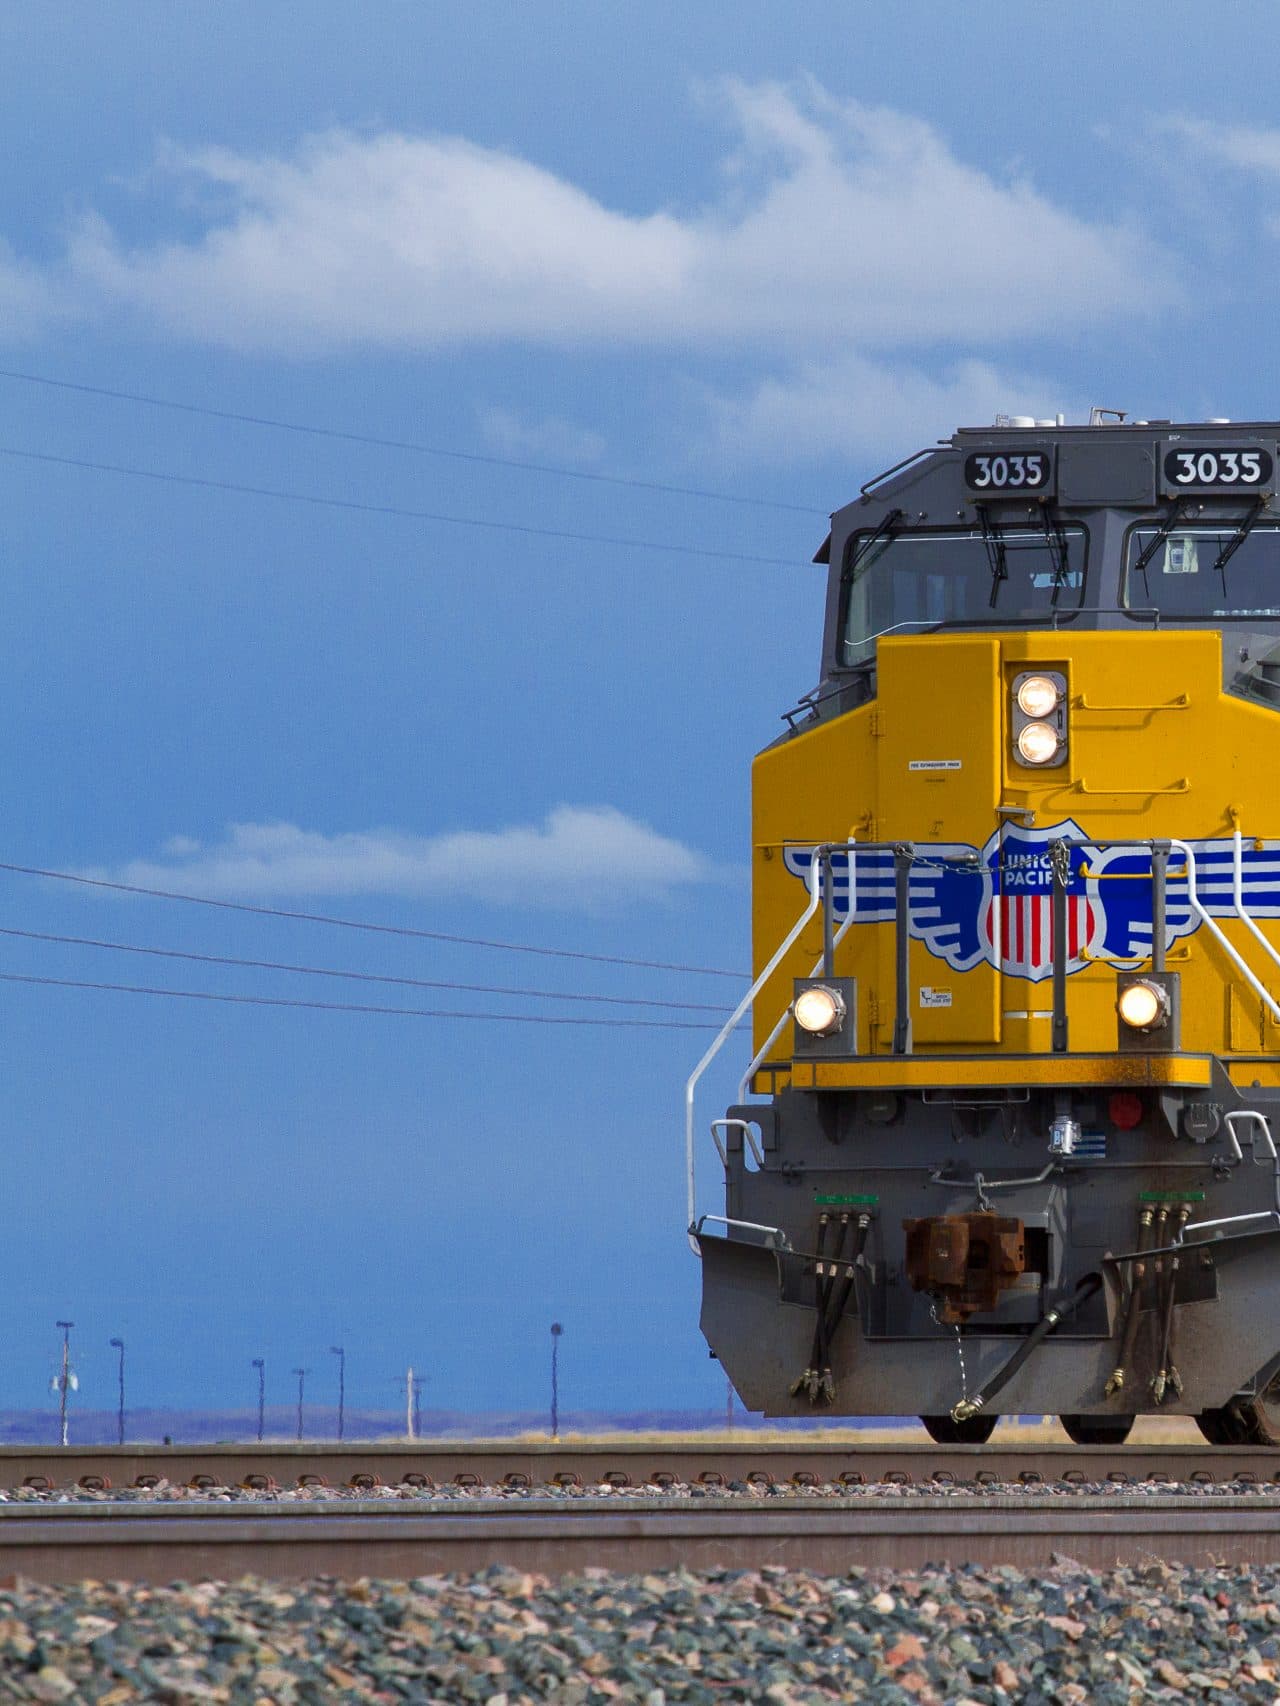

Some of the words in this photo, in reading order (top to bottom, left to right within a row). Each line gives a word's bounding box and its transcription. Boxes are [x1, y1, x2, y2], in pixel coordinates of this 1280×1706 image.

[974, 455, 1042, 487] 3035
[1176, 453, 1261, 483] 3035
[1008, 854, 1070, 869] UNIO
[1005, 871, 1074, 885] PACIFC
